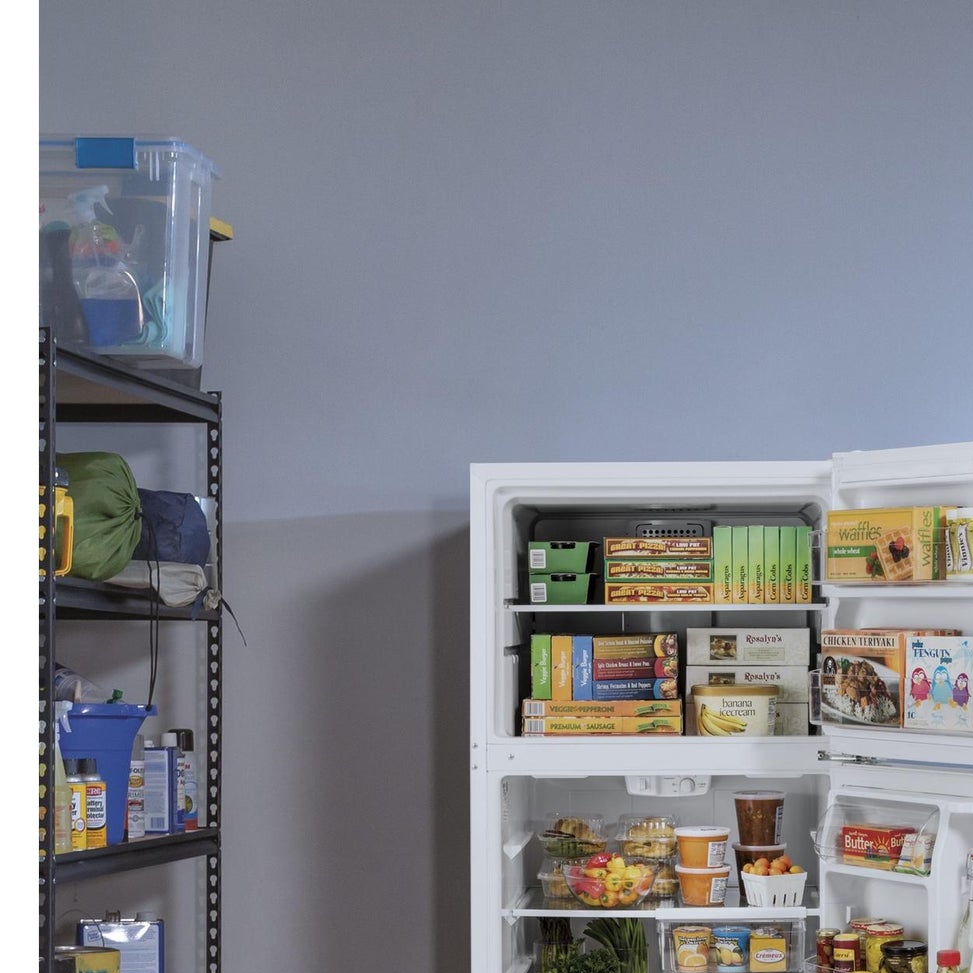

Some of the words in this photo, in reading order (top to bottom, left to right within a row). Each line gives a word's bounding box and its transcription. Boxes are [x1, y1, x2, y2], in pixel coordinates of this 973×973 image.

[918, 510, 932, 567] waffles
[723, 565, 731, 601] Asparagus
[738, 565, 746, 601] Asparagus
[745, 634, 782, 644] Rosalyn's
[823, 635, 857, 646] CHICKEN
[859, 636, 895, 647] TERIYAKI
[580, 649, 588, 667] Burger
[913, 649, 951, 658] PENGUIN
[580, 668, 588, 687] Veggie
[744, 671, 781, 682] Rosalyn's
[722, 698, 753, 708] banana
[719, 708, 756, 717] icecream
[87, 800, 103, 808] attery
[845, 834, 874, 850] Butter
